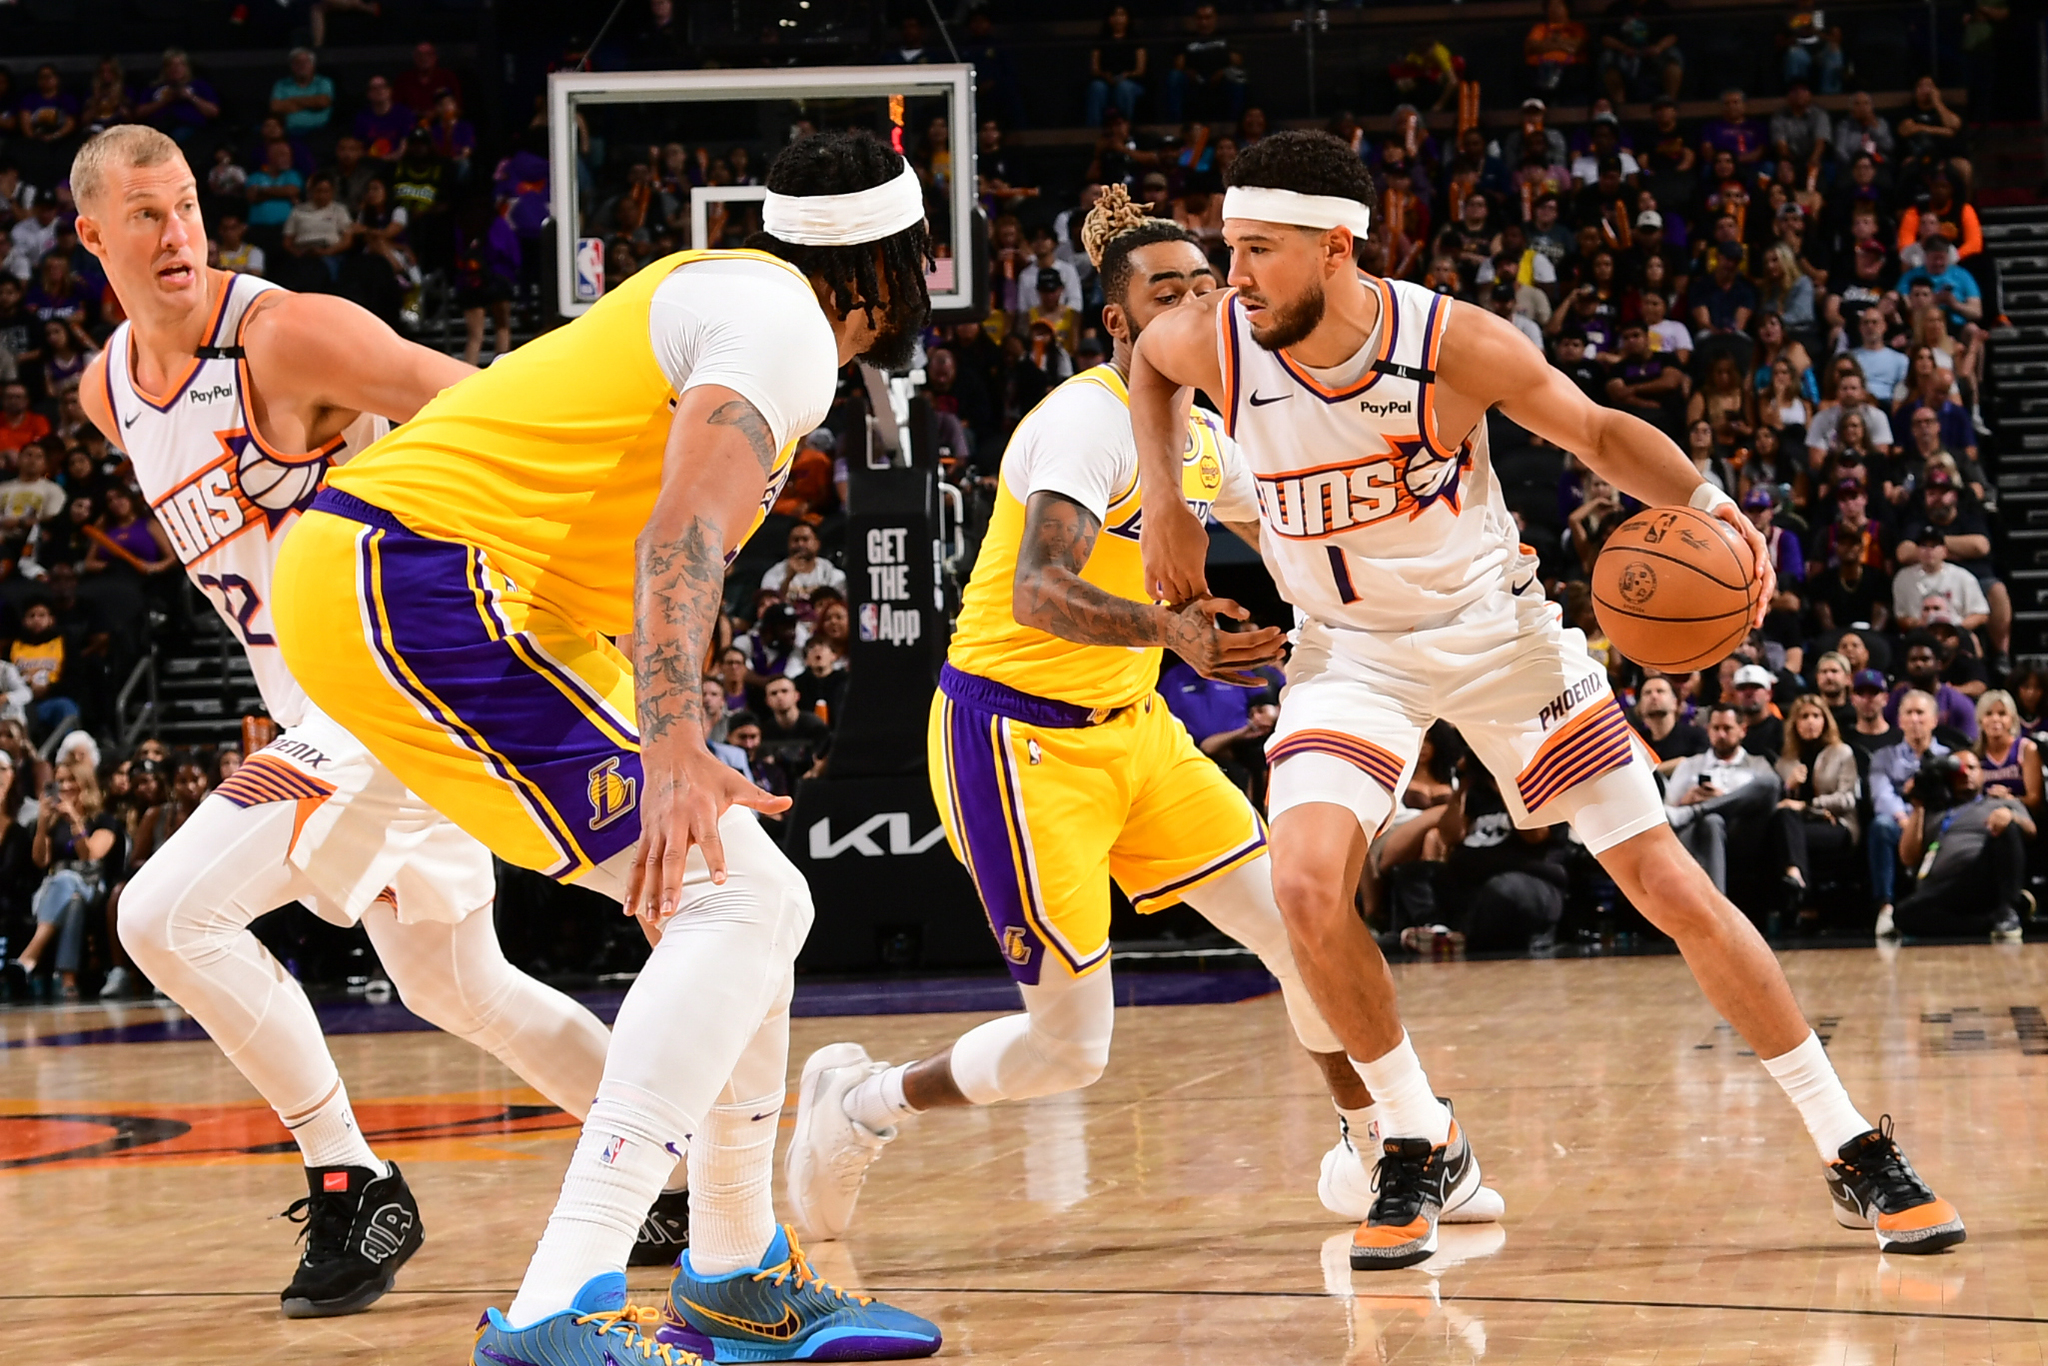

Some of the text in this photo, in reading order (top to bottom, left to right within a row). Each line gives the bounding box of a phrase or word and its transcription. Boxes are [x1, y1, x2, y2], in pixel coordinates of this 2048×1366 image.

[190, 383, 233, 405] PayPal
[1361, 401, 1412, 418] PayPal
[153, 466, 245, 566] UNS
[1253, 459, 1398, 536] UNS
[867, 528, 908, 564] GET
[867, 565, 910, 600] THE
[1325, 545, 1364, 605] 1
[879, 603, 920, 647] App
[1538, 671, 1603, 732] PHOENIX
[361, 1203, 413, 1265] AIR
